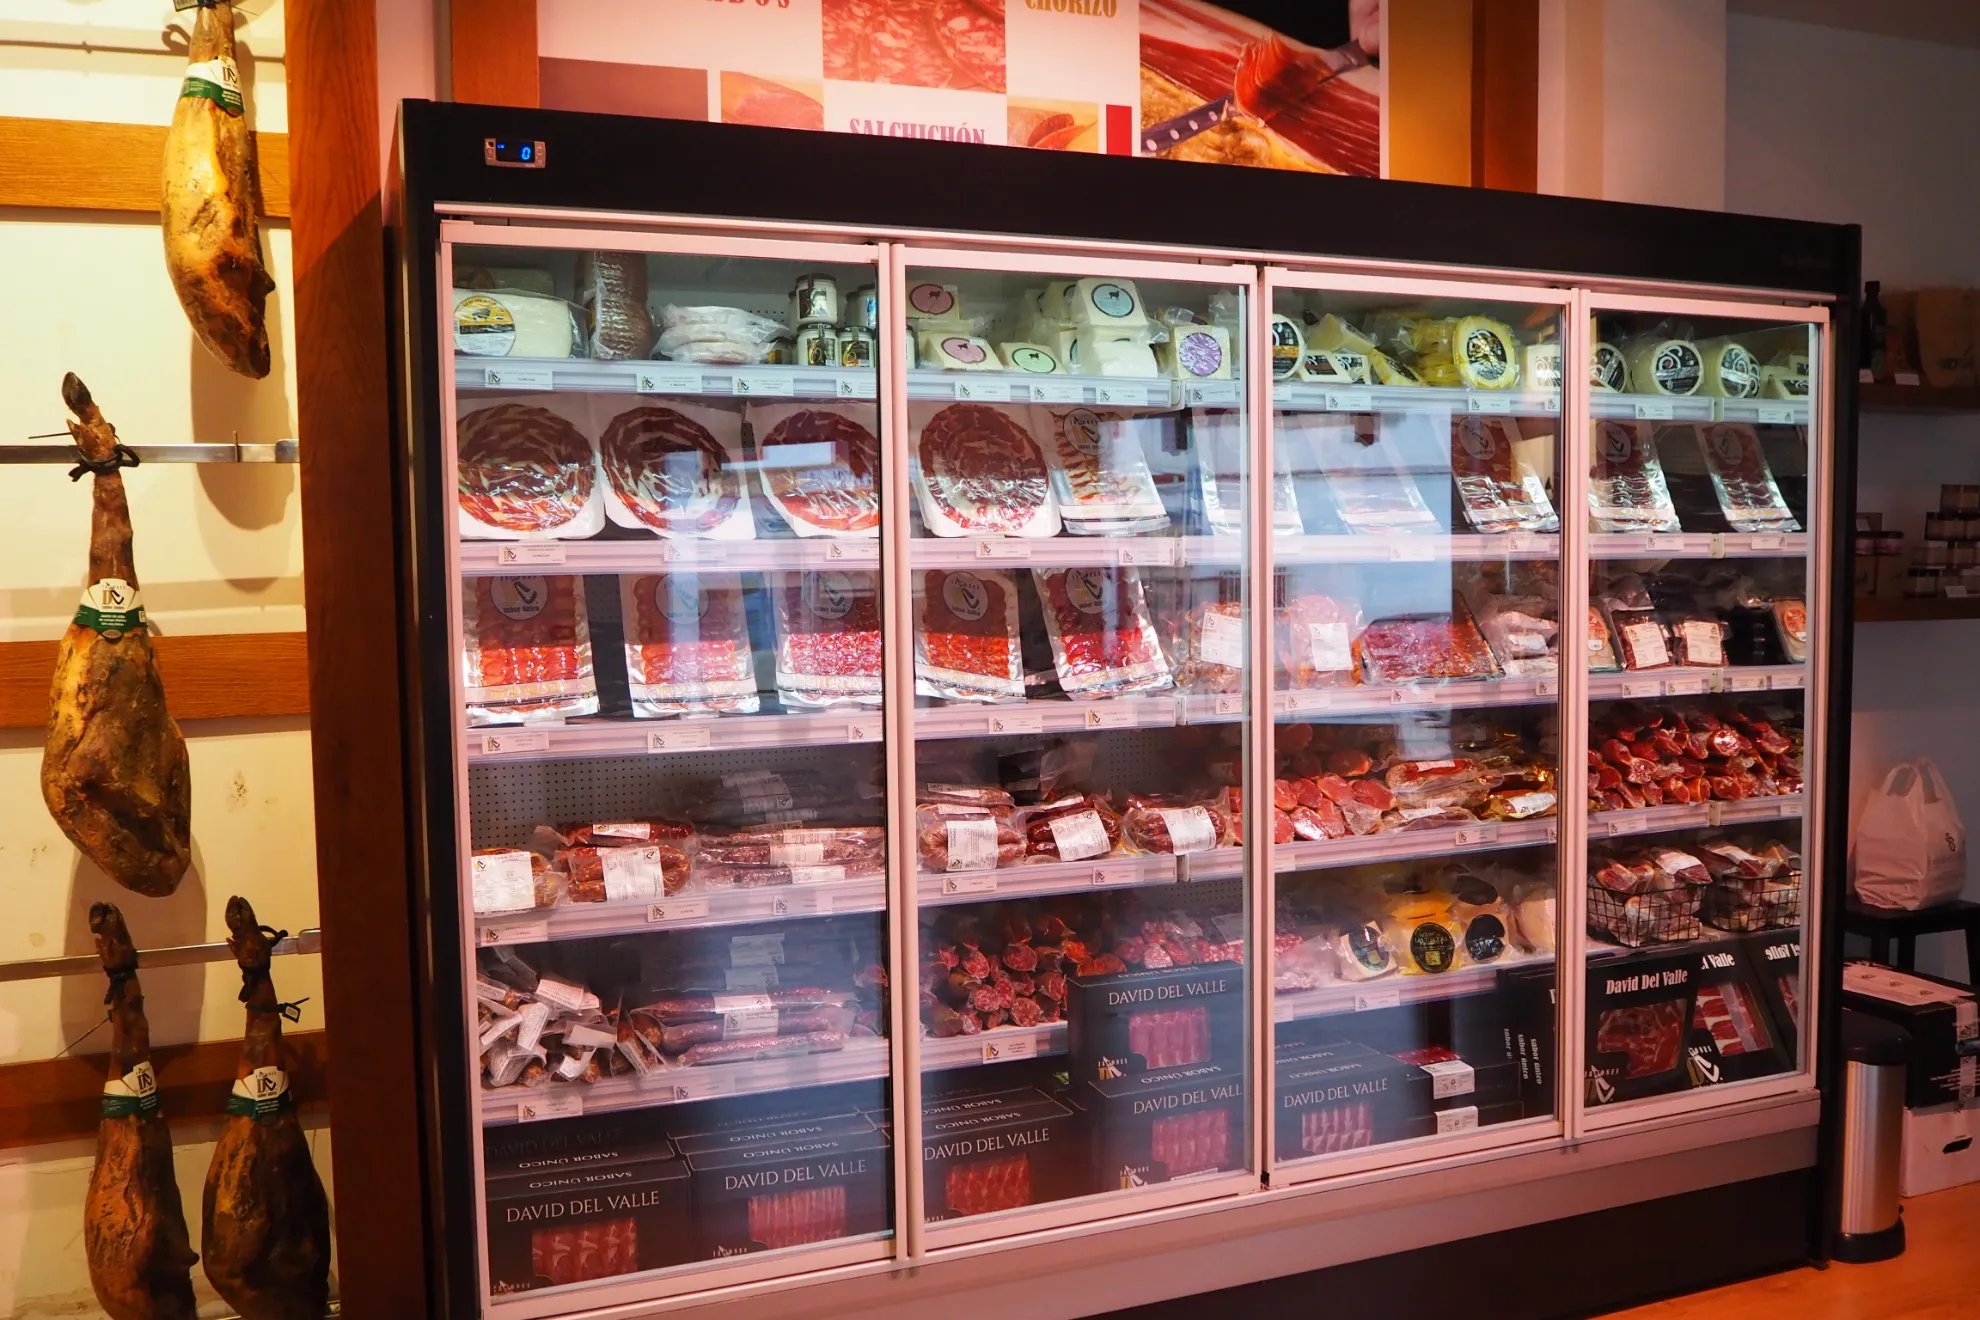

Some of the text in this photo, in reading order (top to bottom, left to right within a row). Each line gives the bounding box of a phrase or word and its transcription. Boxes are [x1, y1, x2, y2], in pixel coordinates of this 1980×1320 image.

[1708, 953, 1735, 968] Valle
[1109, 980, 1227, 1005] DAVID DEL VALLE
[1606, 969, 1688, 995] David Del Valle
[1134, 1084, 1243, 1114] DAVID DEL VALL
[1284, 1078, 1388, 1108] DAVID DEL VALLE
[924, 1128, 1050, 1161] DAVID DEL VALLE
[725, 1159, 867, 1190] DAVID DEL VALLE
[507, 1190, 660, 1222] DAVID DEL VALLE
